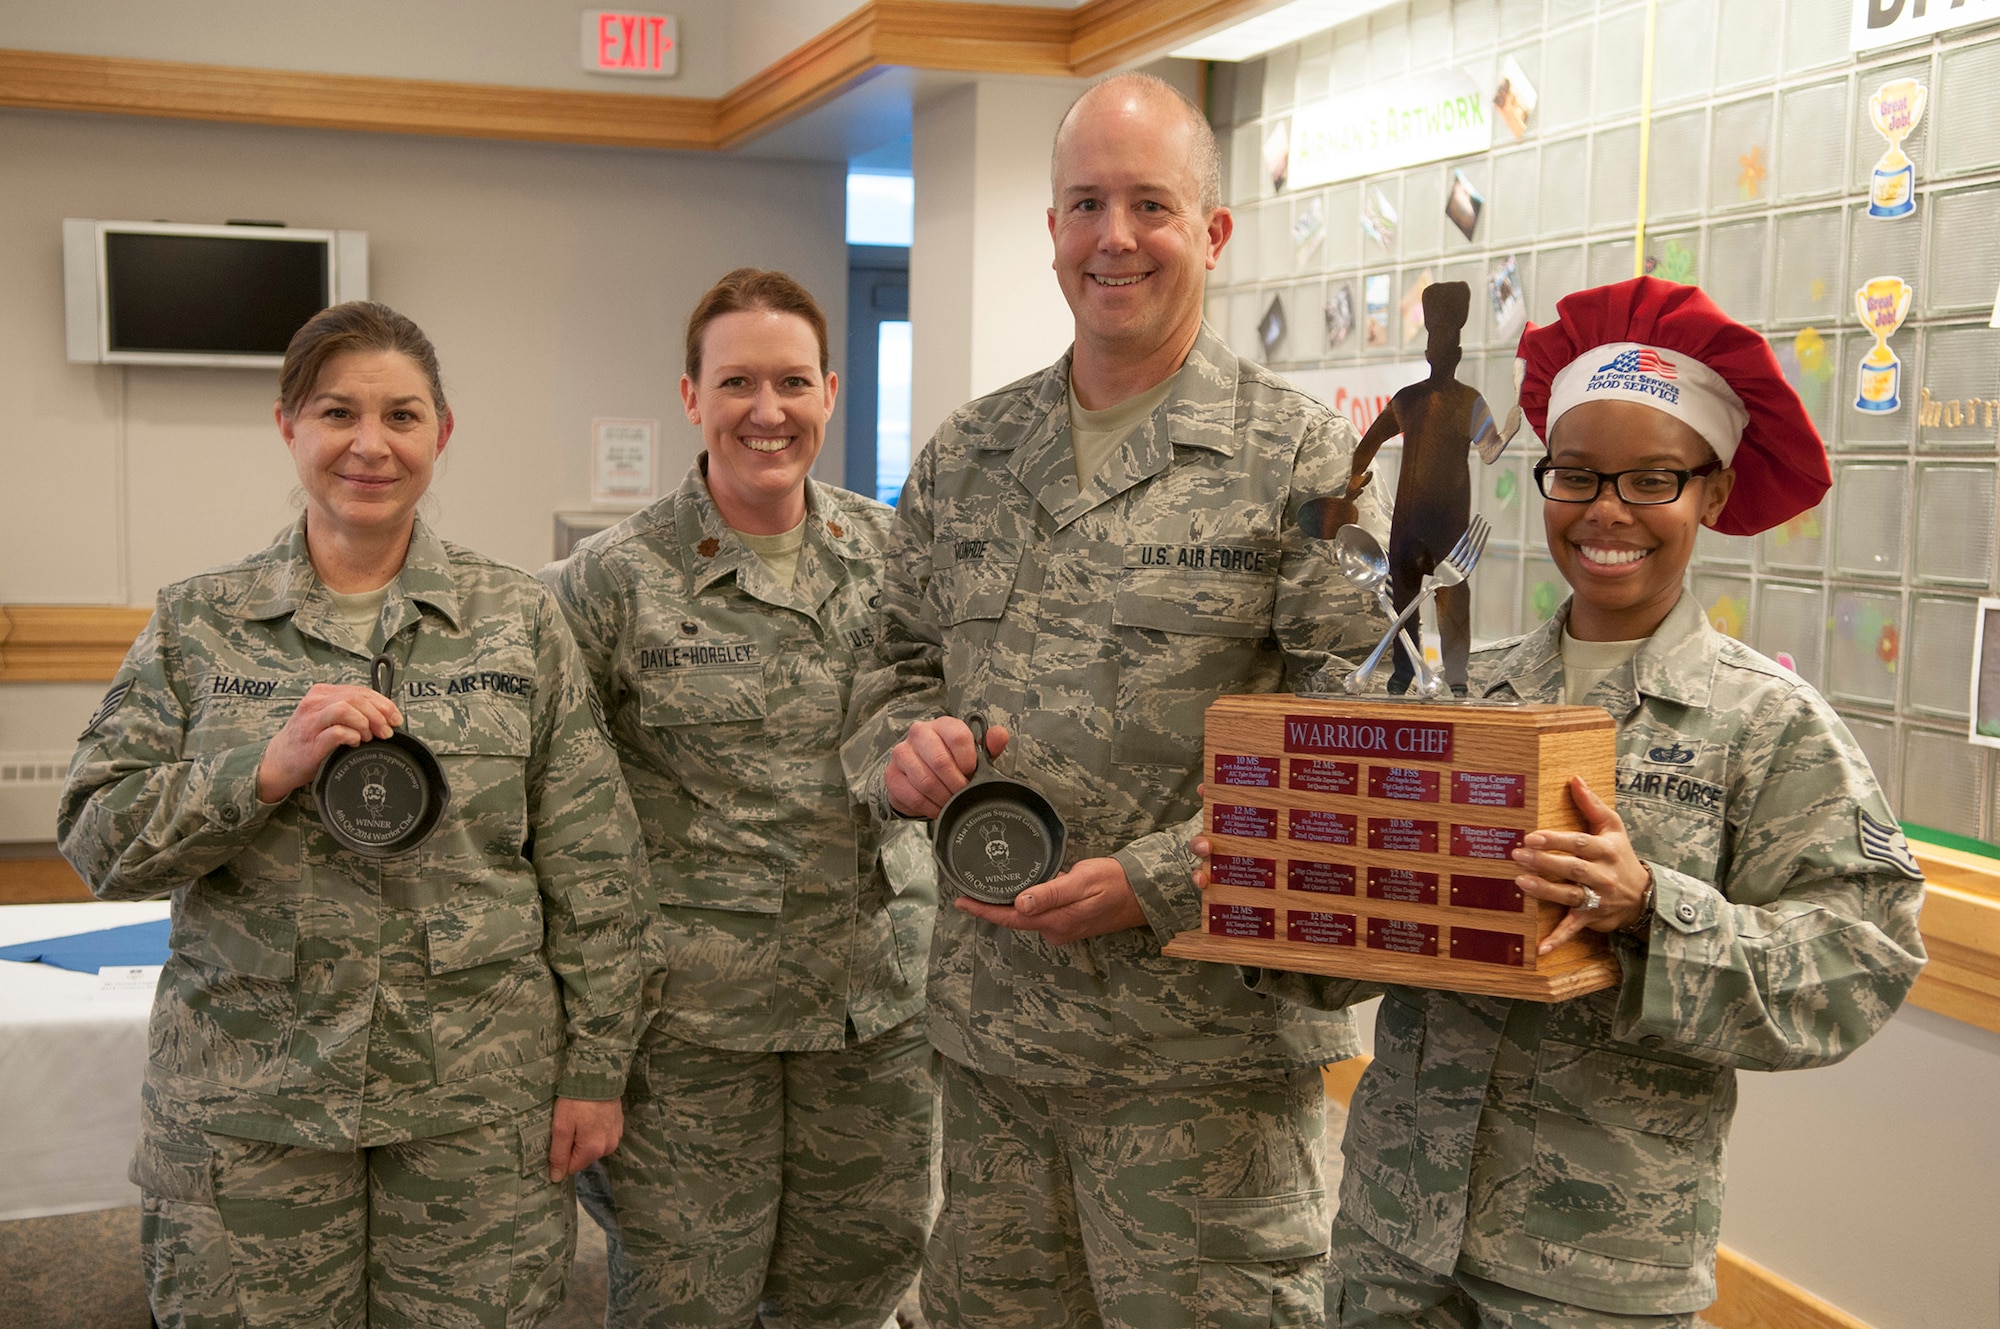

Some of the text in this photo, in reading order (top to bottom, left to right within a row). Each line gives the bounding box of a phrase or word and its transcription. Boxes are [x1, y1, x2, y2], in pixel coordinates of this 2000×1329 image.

[598, 13, 667, 71] EXIT
[1880, 96, 1908, 116] Great
[1386, 90, 1485, 145] ARTWORK
[1888, 111, 1912, 132] Job!
[1867, 293, 1894, 311] Great
[1875, 309, 1897, 327] Job!
[1585, 380, 1680, 405] FOOD SERVICE
[1589, 372, 1680, 395] AIR FORCE SERVICES
[1141, 547, 1265, 571] U.S. AIR FORCE
[641, 644, 752, 669] DAYLE-HORSLEY
[213, 675, 279, 697] HARDY
[409, 673, 531, 698] U.S. AIR FORCE
[1289, 721, 1449, 754] WARRIOR CHEF
[349, 753, 377, 767] Mission
[379, 752, 405, 769] Support
[405, 766, 419, 789] Group
[1246, 757, 1259, 765] MS
[1322, 761, 1336, 769] MS
[1404, 769, 1419, 777] FSS
[1460, 773, 1516, 784] Fitness Center
[1628, 773, 1662, 794] AIR
[1664, 776, 1723, 810] FORCE
[1244, 807, 1256, 815] MS
[336, 809, 414, 840] 4th Qtr 2014 Warrior Chef
[355, 818, 391, 829] WINNER
[968, 811, 992, 829] Mission
[992, 809, 1022, 821] Support
[1022, 817, 1040, 838] Group
[1390, 819, 1413, 828] 10 MS
[1460, 827, 1516, 838] Fitness Center
[1308, 833, 1332, 841] Quarter
[964, 861, 1042, 894] 4th Qtr 2014 Warrior Chef
[985, 872, 1021, 883] WINNER
[1400, 871, 1413, 879] MS
[1320, 913, 1333, 921] MS
[1403, 921, 1417, 930] FSS
